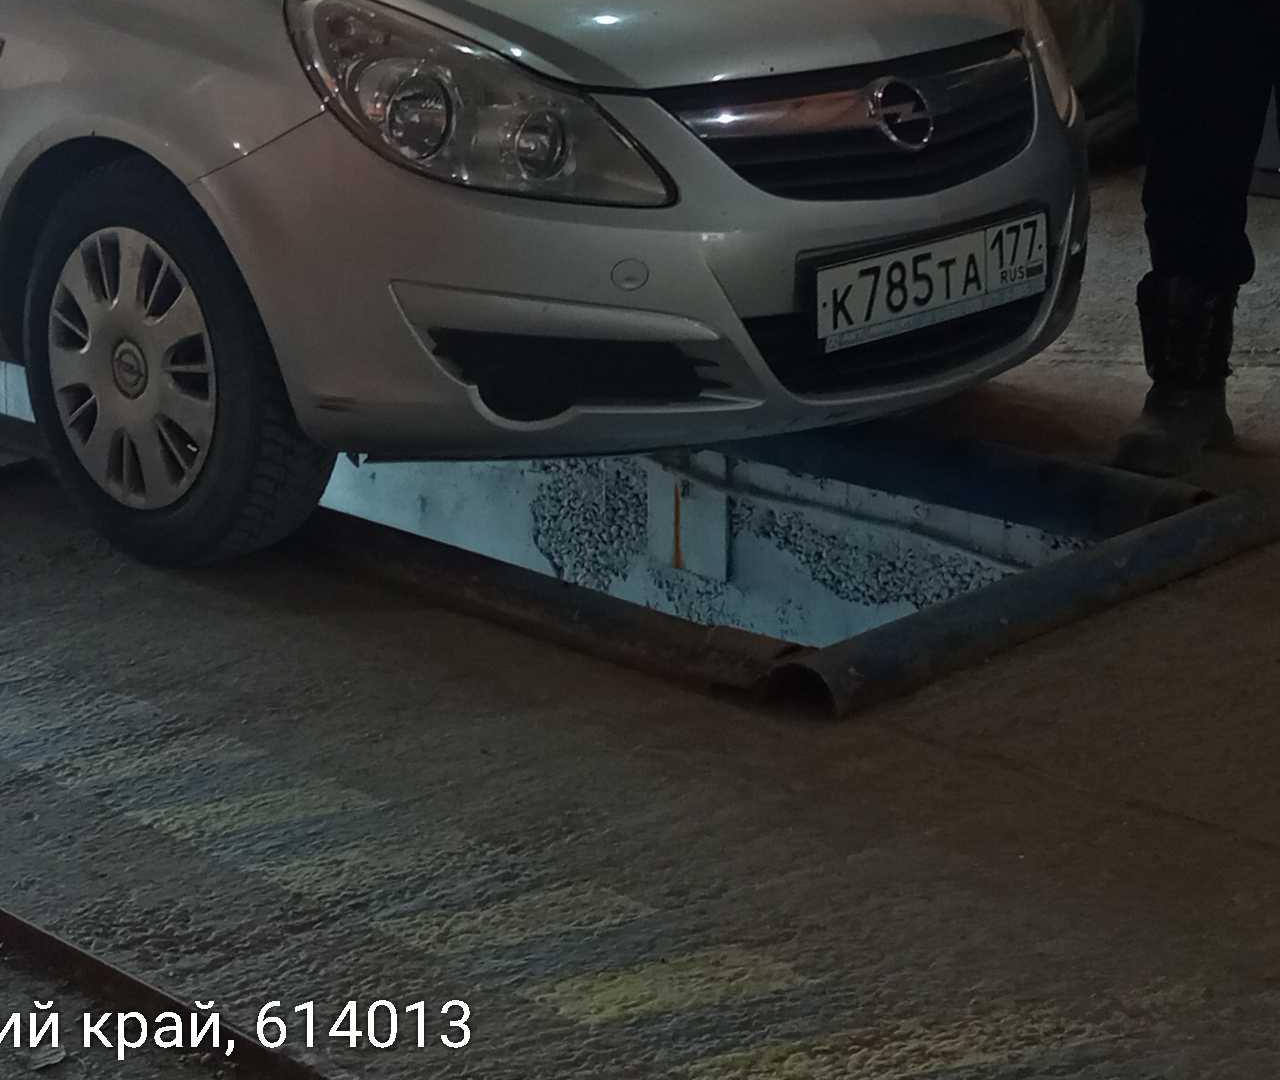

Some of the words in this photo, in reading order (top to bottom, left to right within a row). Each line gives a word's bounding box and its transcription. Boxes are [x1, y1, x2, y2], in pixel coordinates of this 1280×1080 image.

[833, 252, 982, 330] К785ТА
[990, 220, 1038, 269] 177
[1001, 266, 1025, 284] RUS
